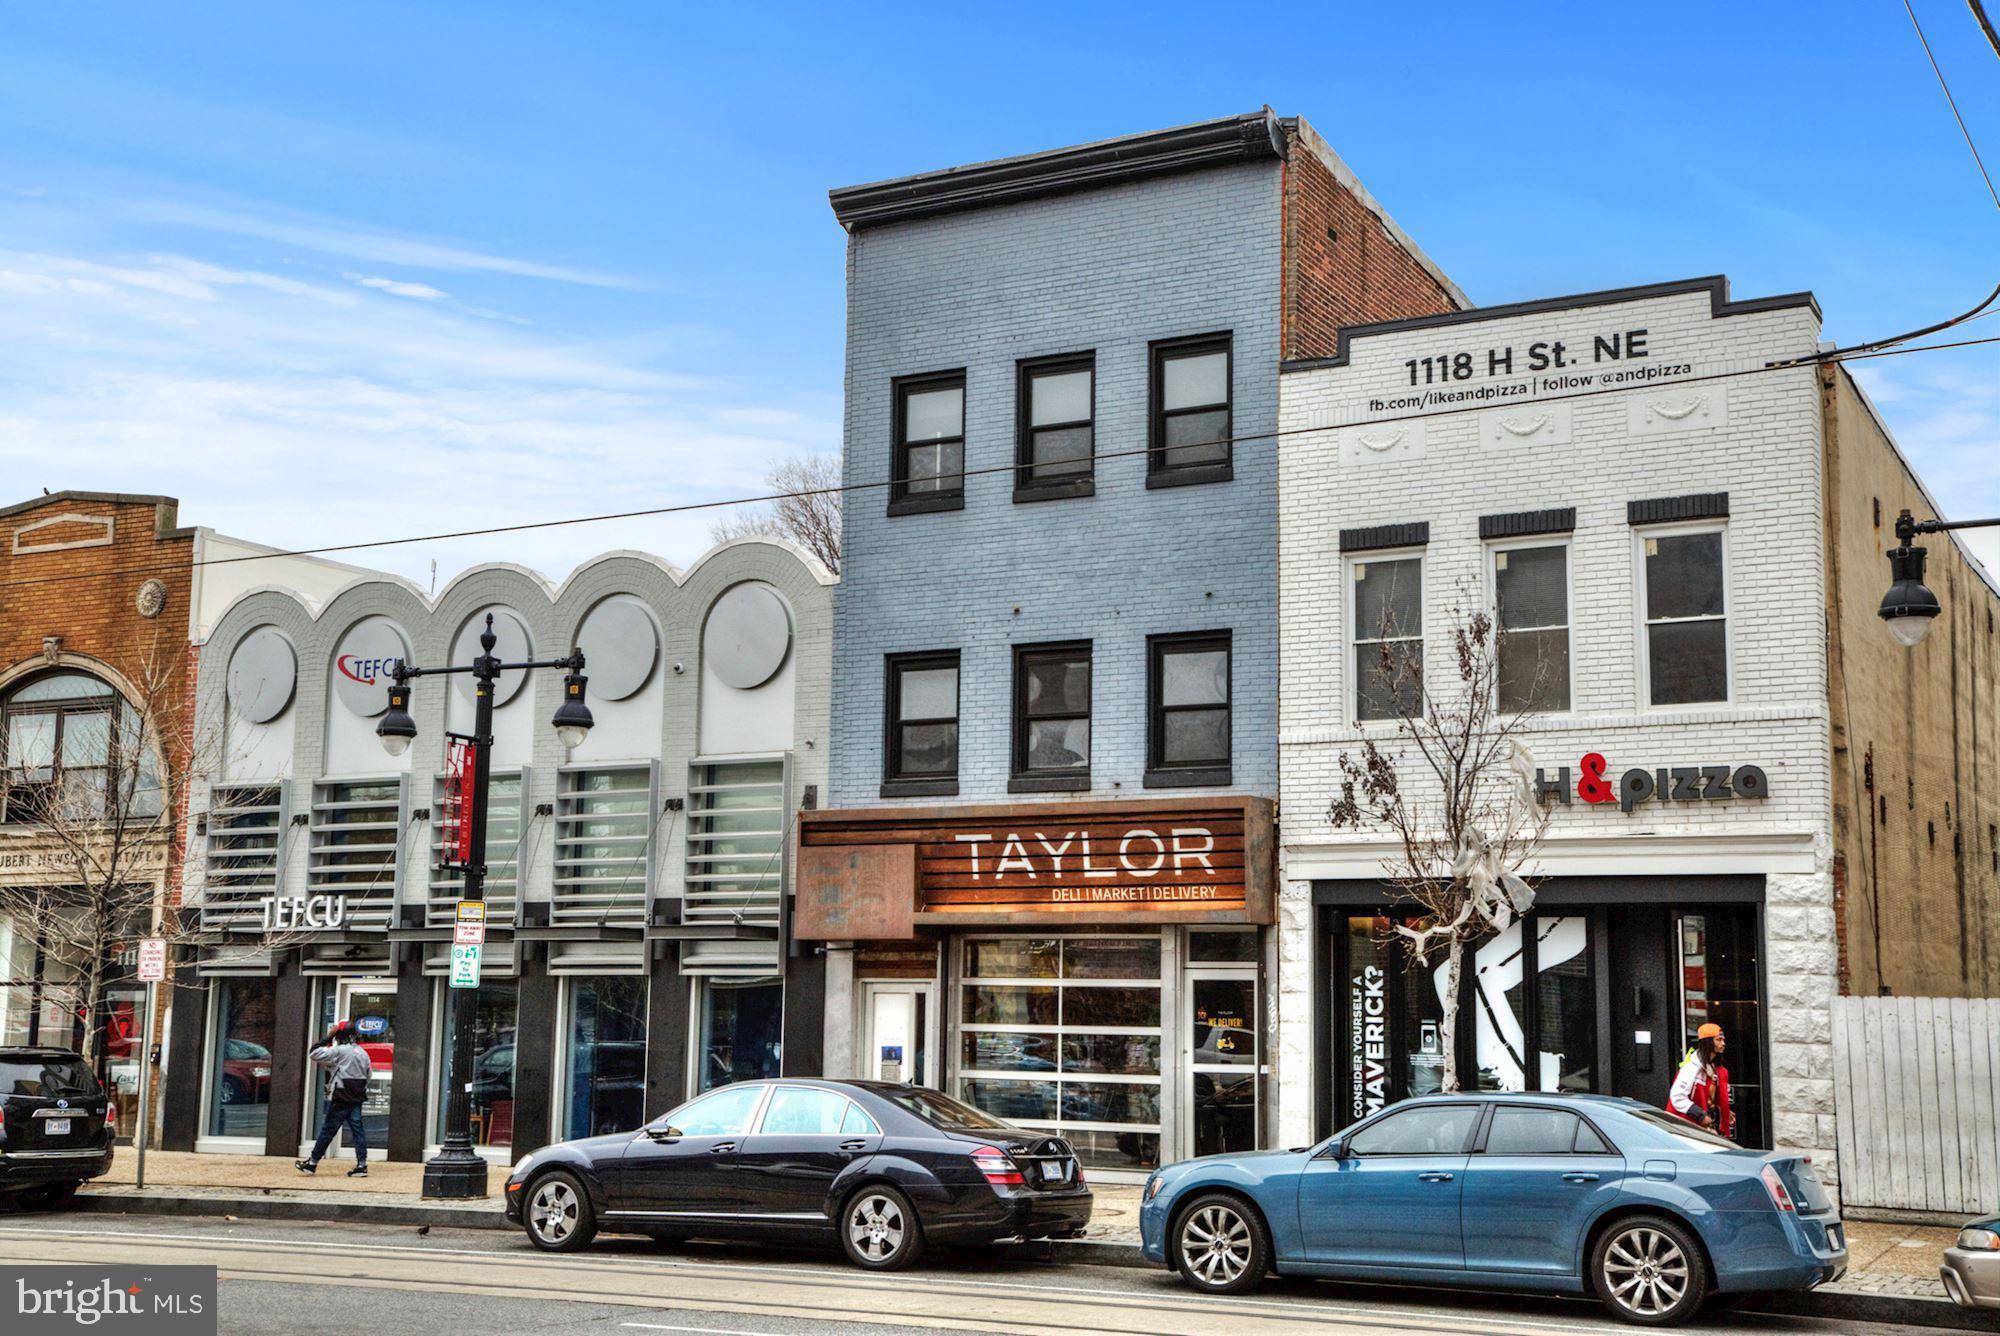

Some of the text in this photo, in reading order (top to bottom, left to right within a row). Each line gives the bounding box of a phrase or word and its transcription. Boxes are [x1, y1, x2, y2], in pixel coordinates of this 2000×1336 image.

[1405, 329, 1649, 386] 1118 H St. NE
[1369, 363, 1692, 412] fb.com/likeandpizza follow @andpizza
[354, 658, 398, 679] TEFC
[955, 827, 1216, 880] TAYLOR
[260, 894, 346, 928] TEFCU
[1052, 886, 1217, 902] DELI MARKET DELIVERY
[1353, 975, 1363, 1119] CONSIDER YOURSELF A
[1365, 965, 1385, 1117] MAVERICK?
